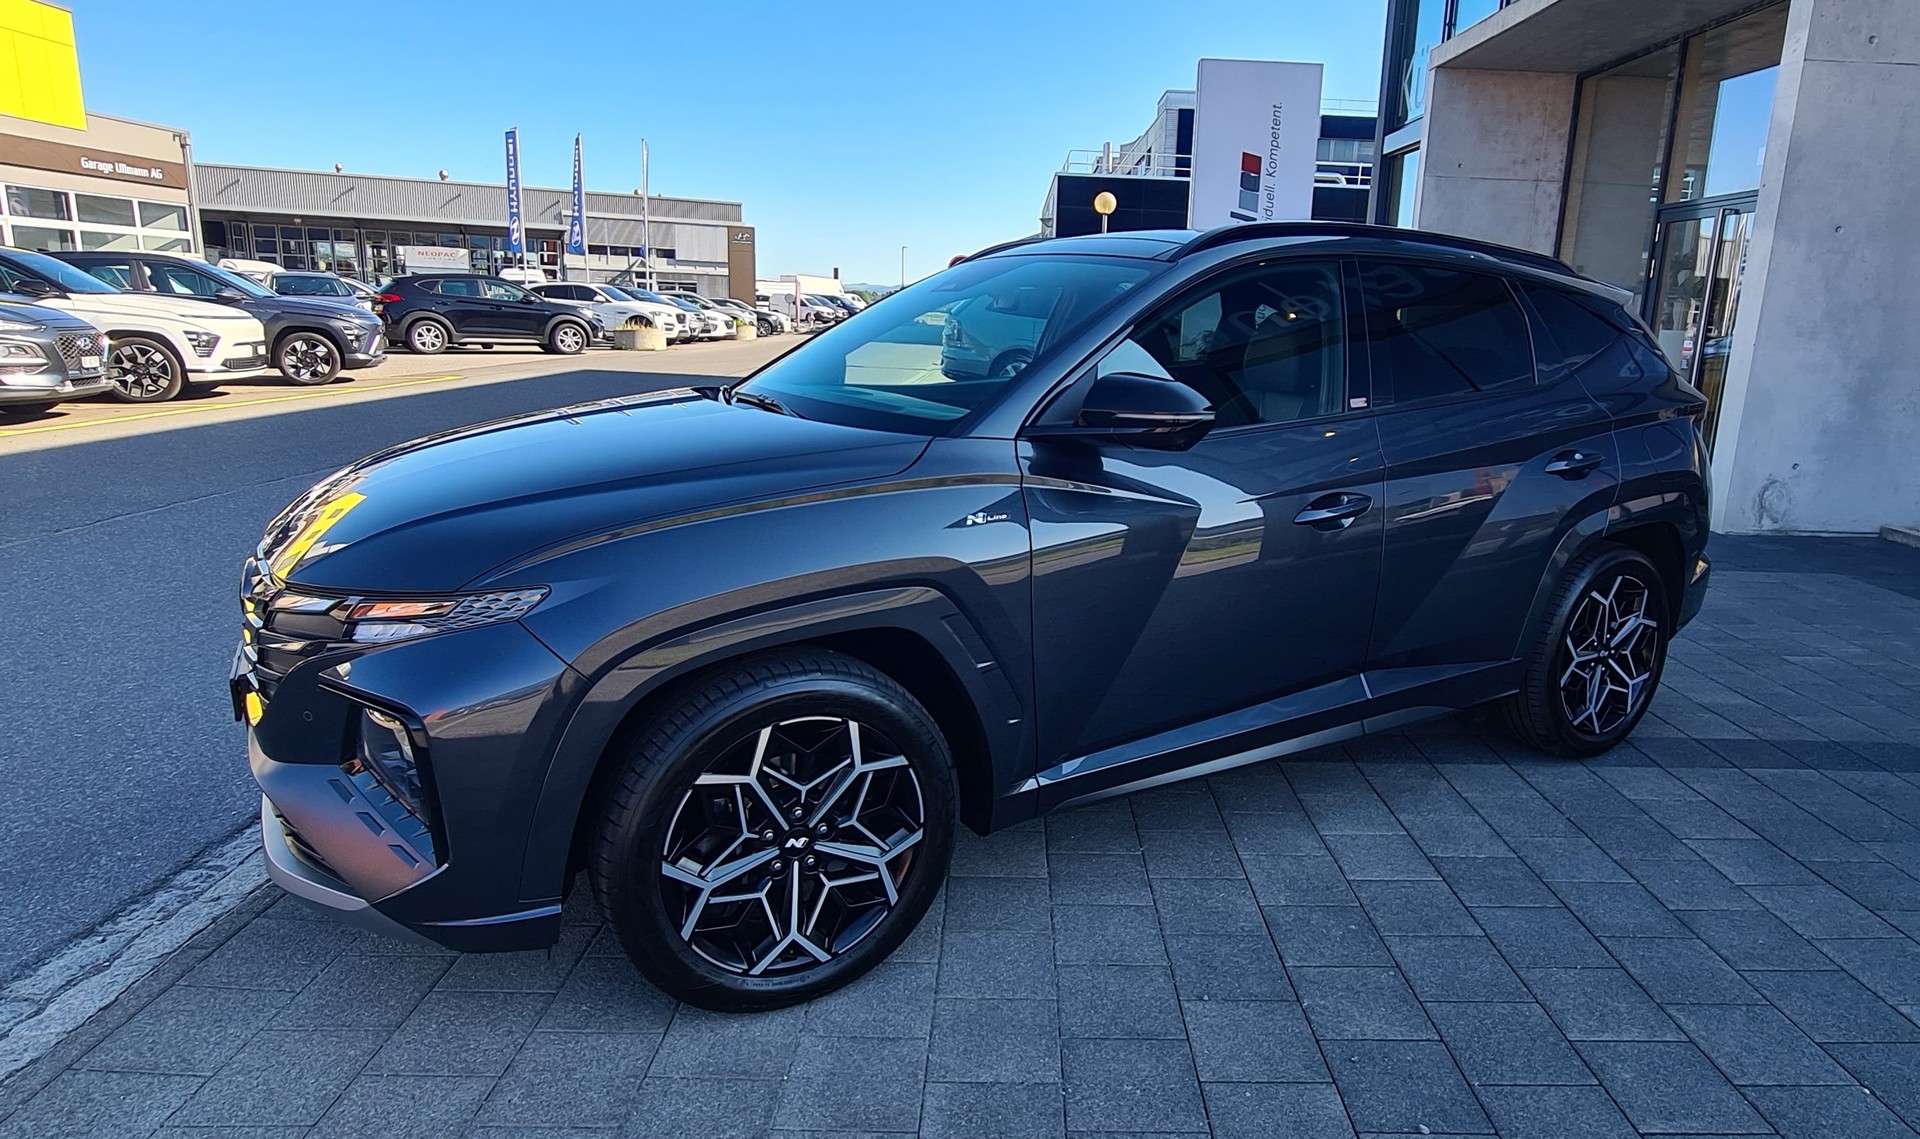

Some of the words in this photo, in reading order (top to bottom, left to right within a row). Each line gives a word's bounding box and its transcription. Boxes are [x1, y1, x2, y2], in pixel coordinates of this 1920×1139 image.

[1266, 102, 1283, 178] Kompetent.
[80, 156, 113, 174] Garage
[114, 162, 149, 178] Ullmann
[150, 167, 163, 180] AG
[508, 138, 518, 213] HYUNDAI
[1262, 183, 1275, 222] iduell.
[417, 250, 456, 258] NEOPAC
